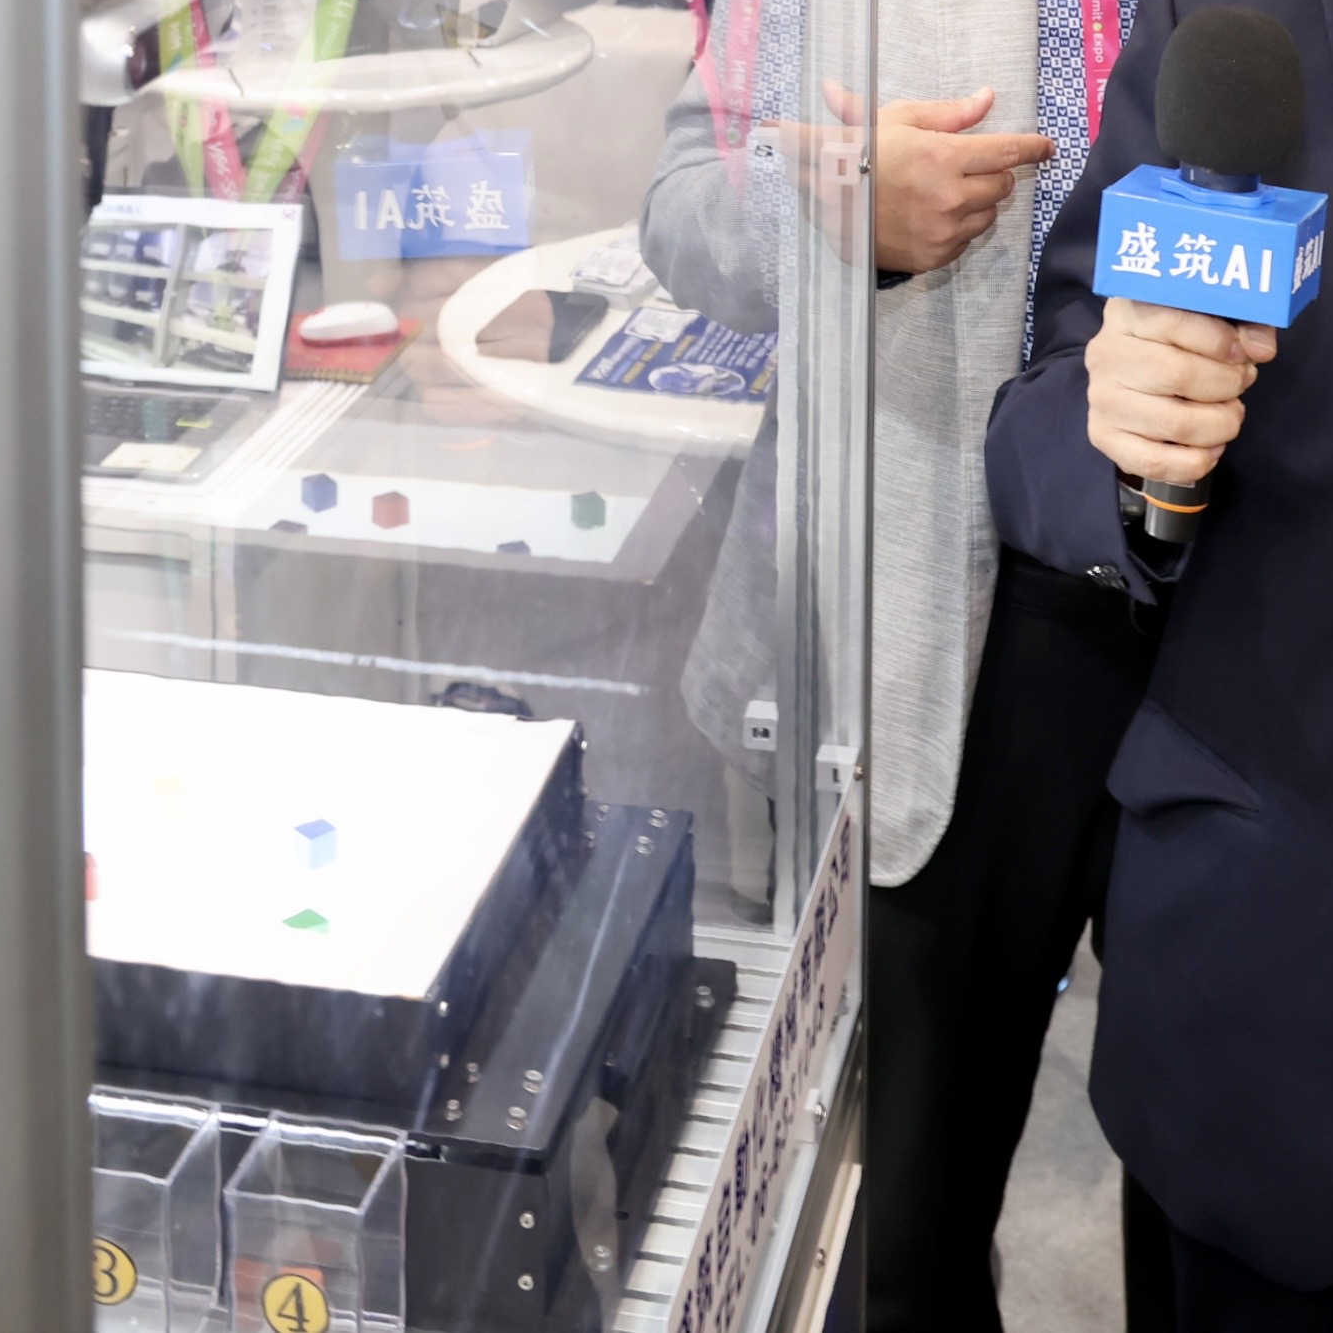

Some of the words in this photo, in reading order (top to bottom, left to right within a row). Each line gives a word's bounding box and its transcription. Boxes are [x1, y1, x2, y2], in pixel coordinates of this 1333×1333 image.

[1093, 33, 1104, 64] Expo
[1110, 221, 1273, 294] 盛筑AI
[94, 1243, 119, 1299] 3
[276, 1281, 311, 1333] 4
